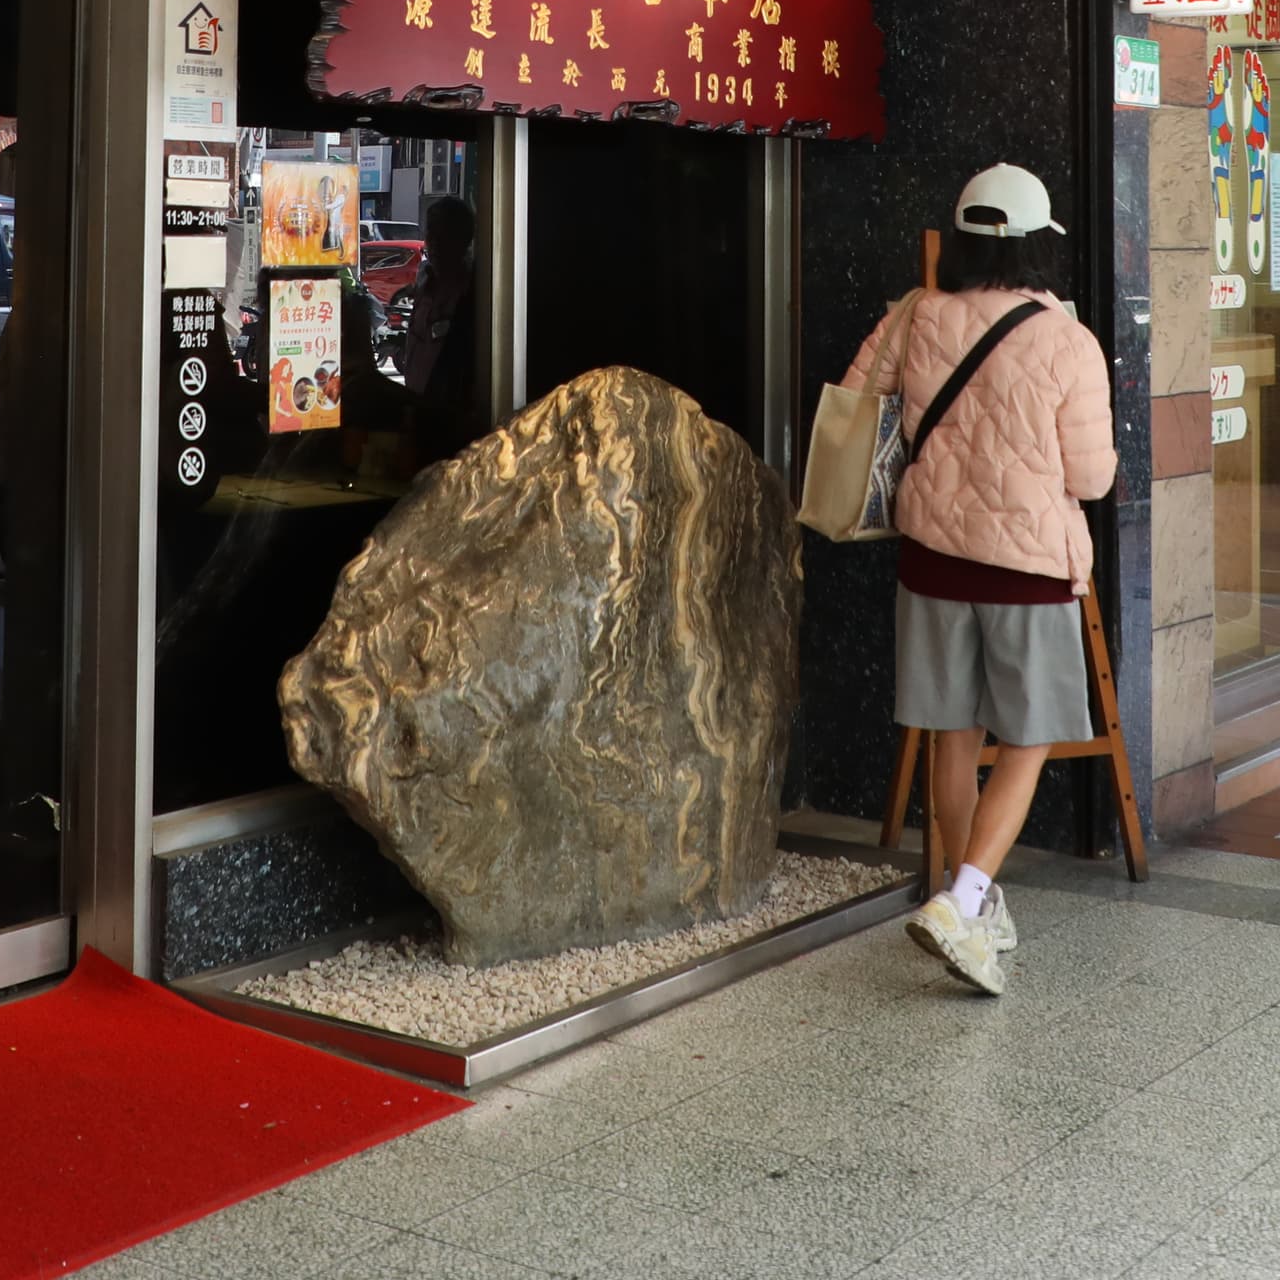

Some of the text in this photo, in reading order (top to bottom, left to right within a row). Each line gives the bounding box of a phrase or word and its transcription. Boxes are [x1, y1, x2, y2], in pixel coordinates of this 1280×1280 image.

[1130, 67, 1155, 97] 314
[173, 158, 221, 176] 營業時間
[166, 210, 226, 227] 11:30~21:00
[173, 295, 216, 313] 晚餐最後
[173, 315, 216, 332] 點餐時間
[179, 332, 208, 349] 20:15
